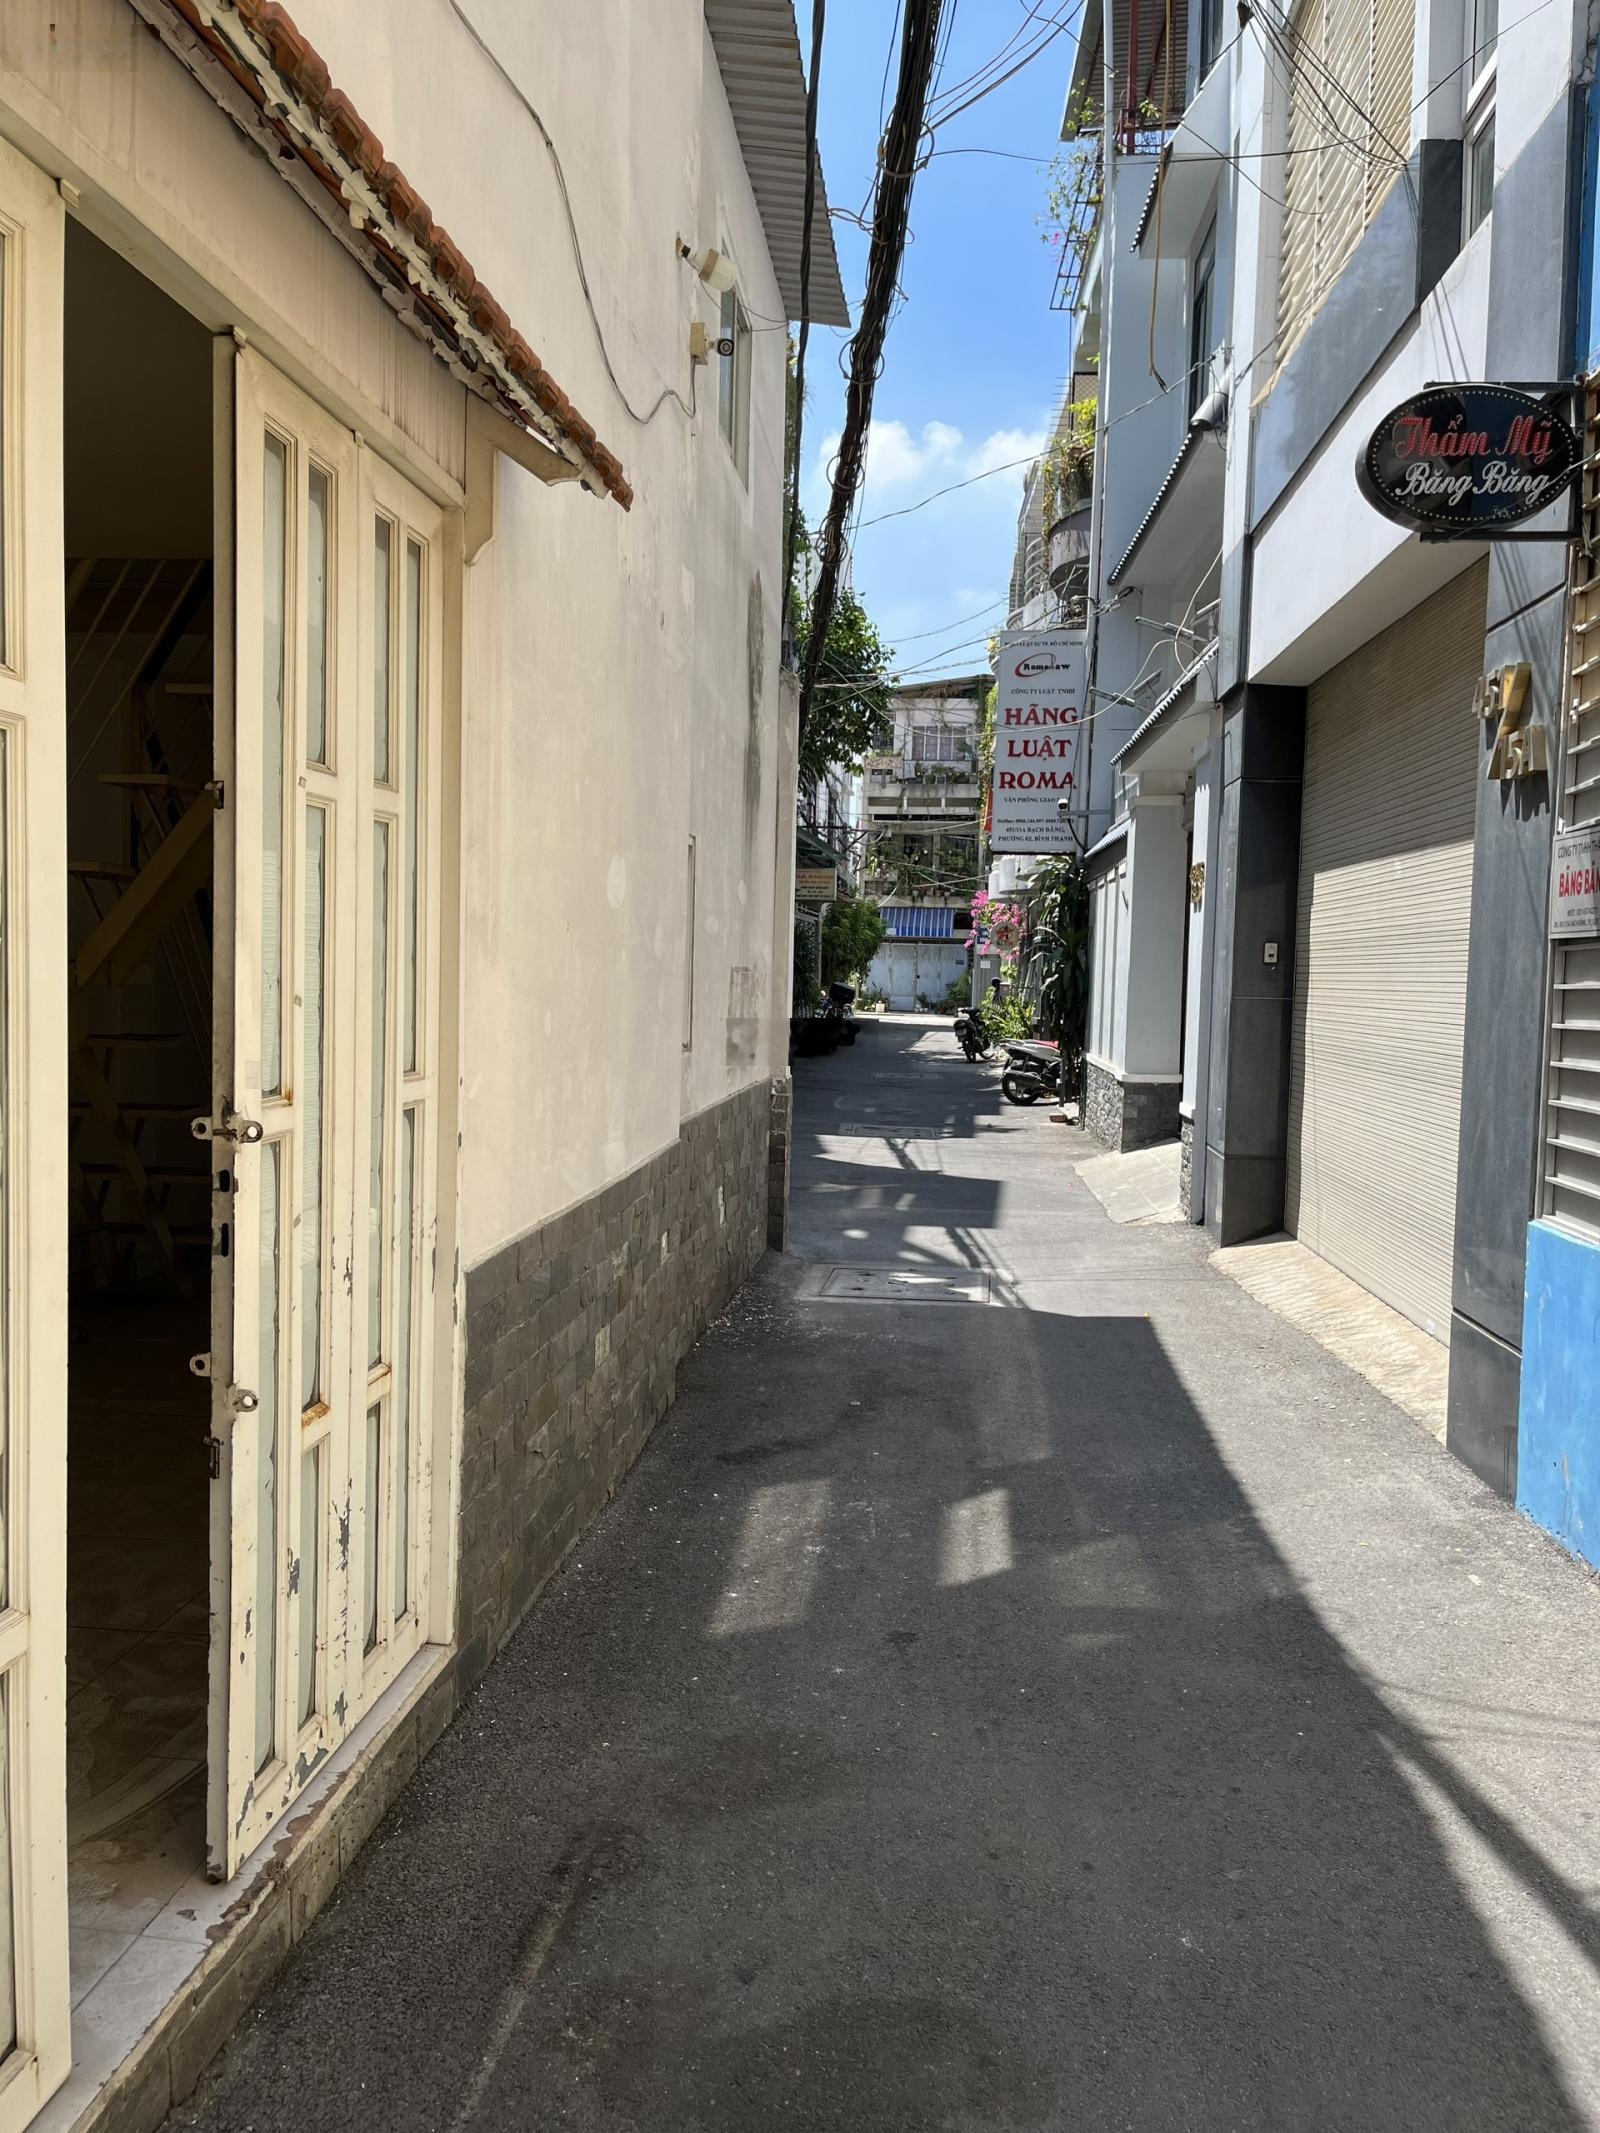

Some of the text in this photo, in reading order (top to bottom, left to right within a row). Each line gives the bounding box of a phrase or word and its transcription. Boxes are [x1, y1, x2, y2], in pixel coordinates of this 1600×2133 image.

[1392, 414, 1553, 466] Thẩm Mỹ
[1395, 460, 1549, 506] Băng Băng
[1004, 703, 1079, 726] HÃNG
[1007, 735, 1072, 761] LUẬT
[998, 771, 1077, 790] ROMA
[1558, 845, 1572, 859] CÔNG
[1572, 844, 1578, 857] TY
[1558, 860, 1600, 898] BĂNG BĂN
